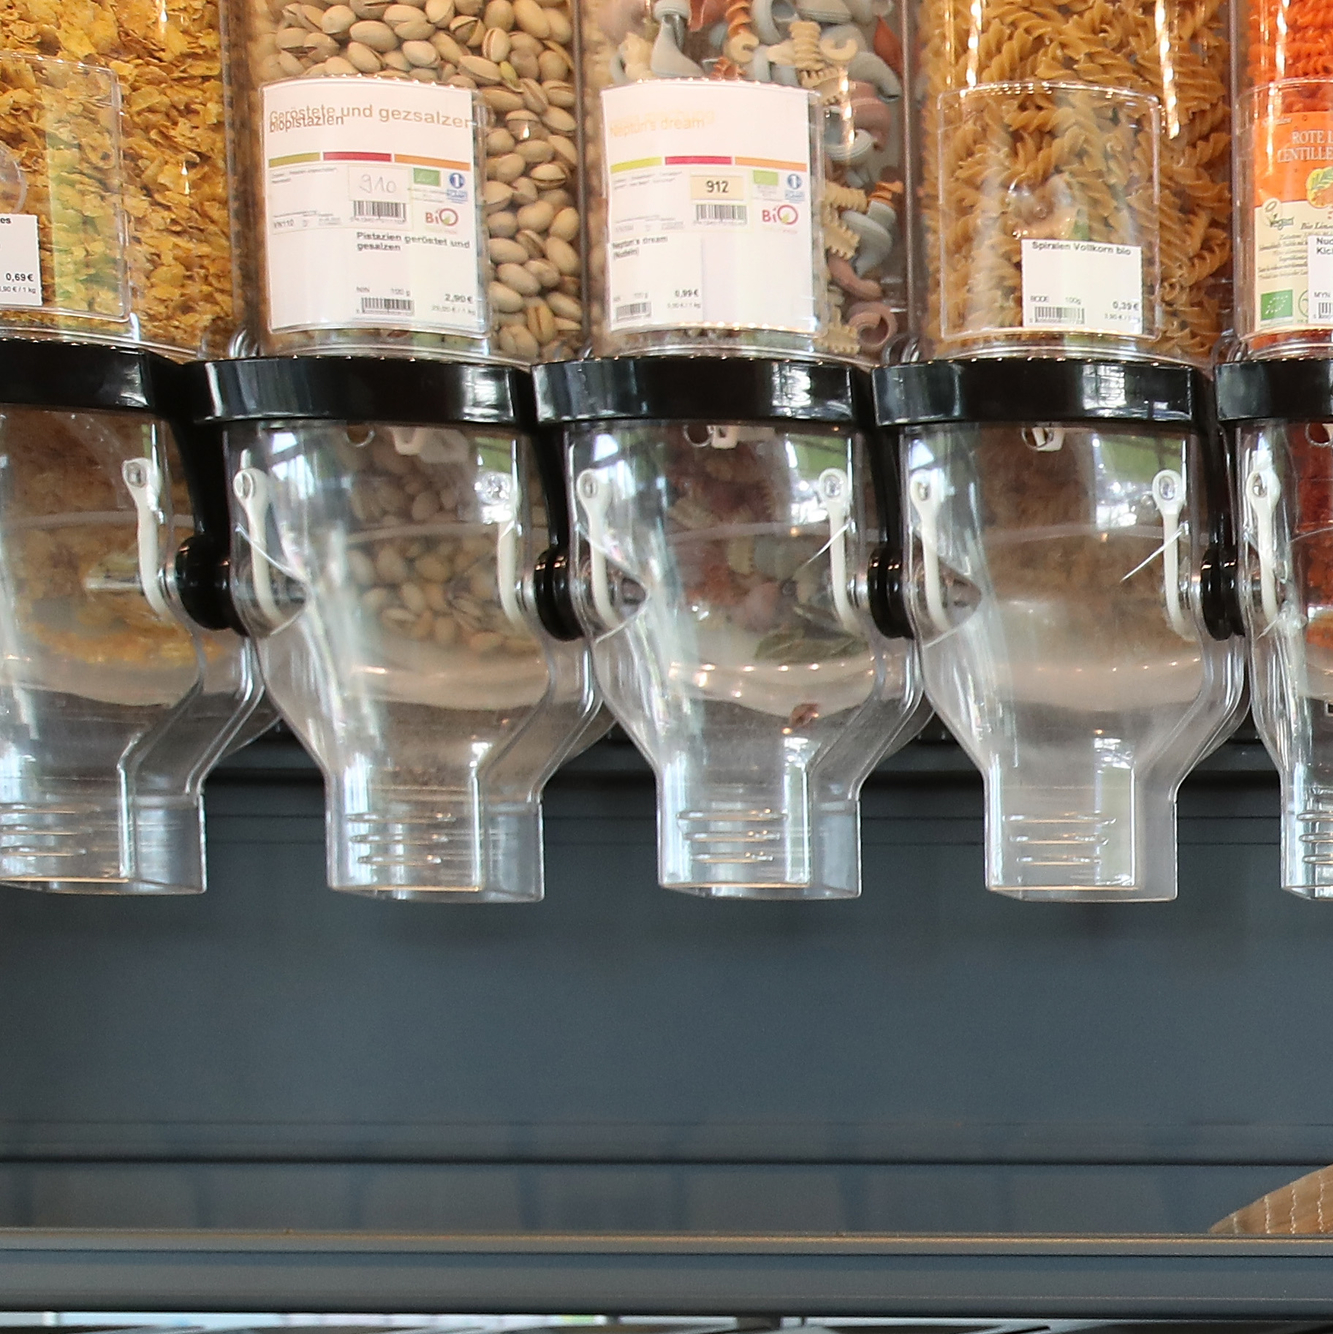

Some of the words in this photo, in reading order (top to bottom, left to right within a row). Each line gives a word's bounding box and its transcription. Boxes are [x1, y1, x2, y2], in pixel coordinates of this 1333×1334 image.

[341, 104, 373, 118] und
[1292, 131, 1324, 144] ROTE
[359, 174, 397, 194] 910
[705, 181, 729, 193] 912
[356, 232, 401, 242] Pistazien
[405, 235, 447, 246] geröstet
[451, 240, 470, 249] und
[358, 243, 401, 251] gesalzen
